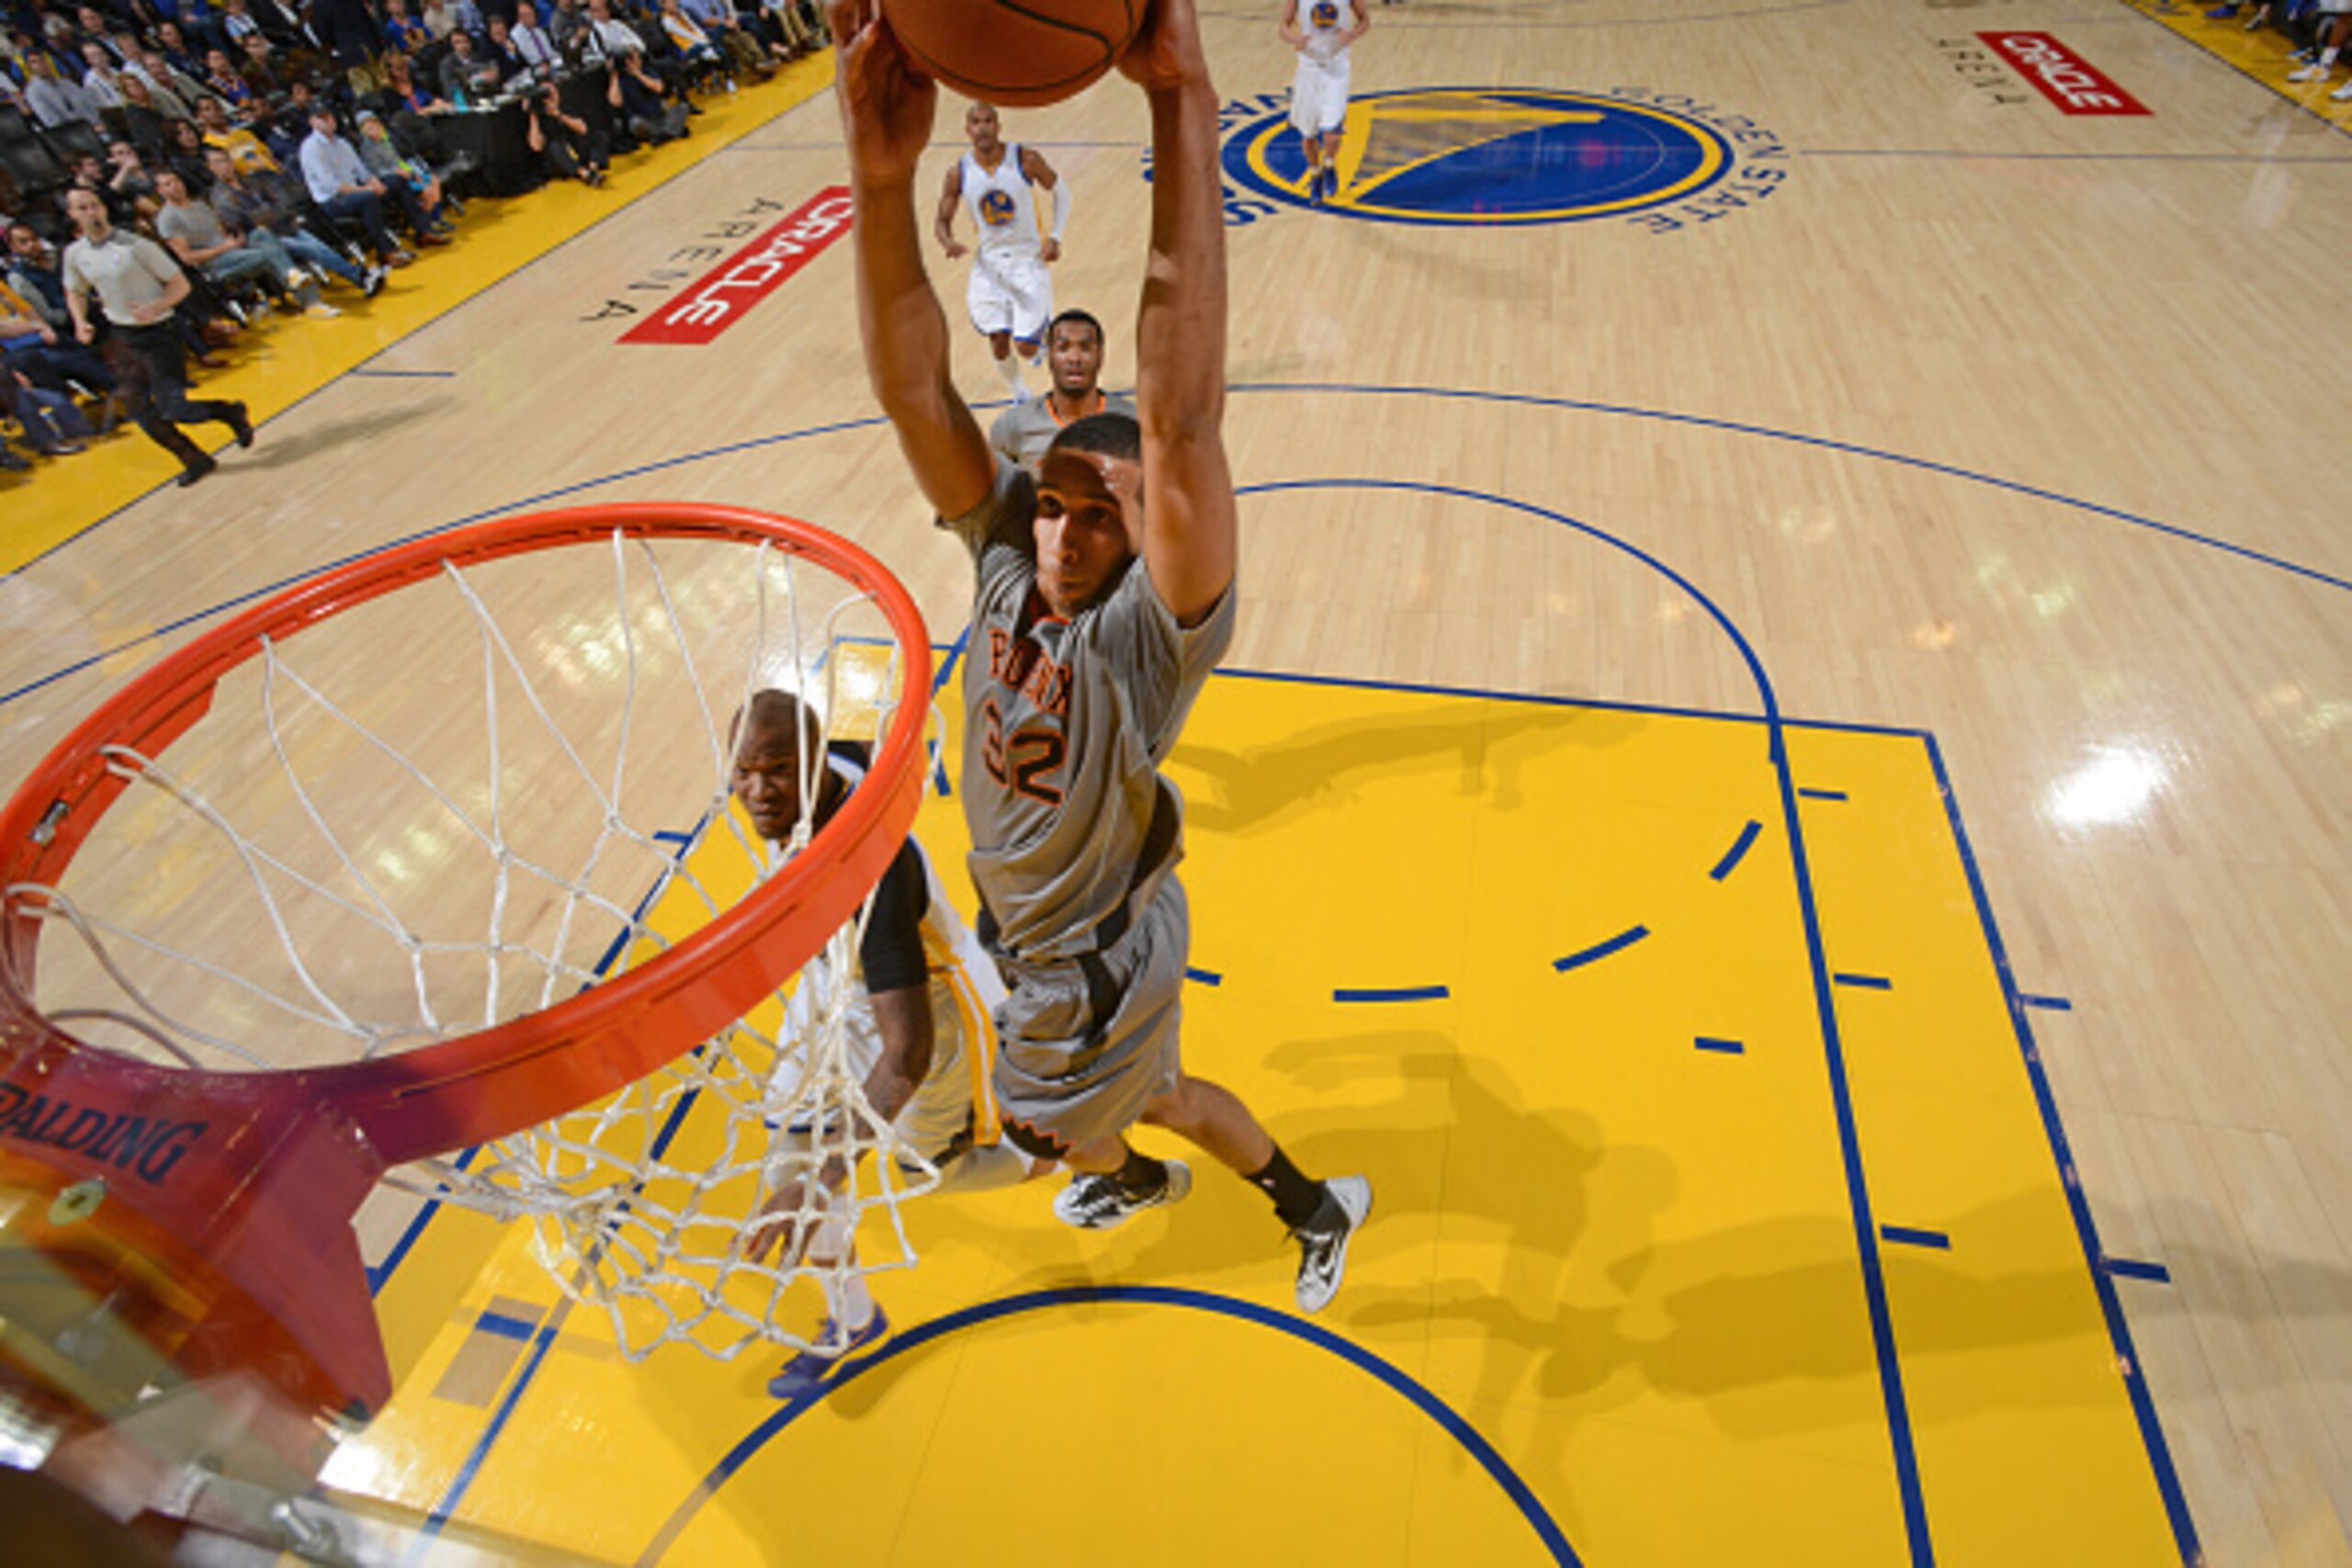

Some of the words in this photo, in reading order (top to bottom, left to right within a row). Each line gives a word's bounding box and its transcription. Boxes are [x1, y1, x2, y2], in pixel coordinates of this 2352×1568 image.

[2002, 35, 2122, 108] ORACLE
[1626, 166, 1786, 234] STATE
[578, 196, 785, 323] ARENA
[664, 196, 854, 326] ORACLE
[0, 1080, 208, 1186] PALDING
